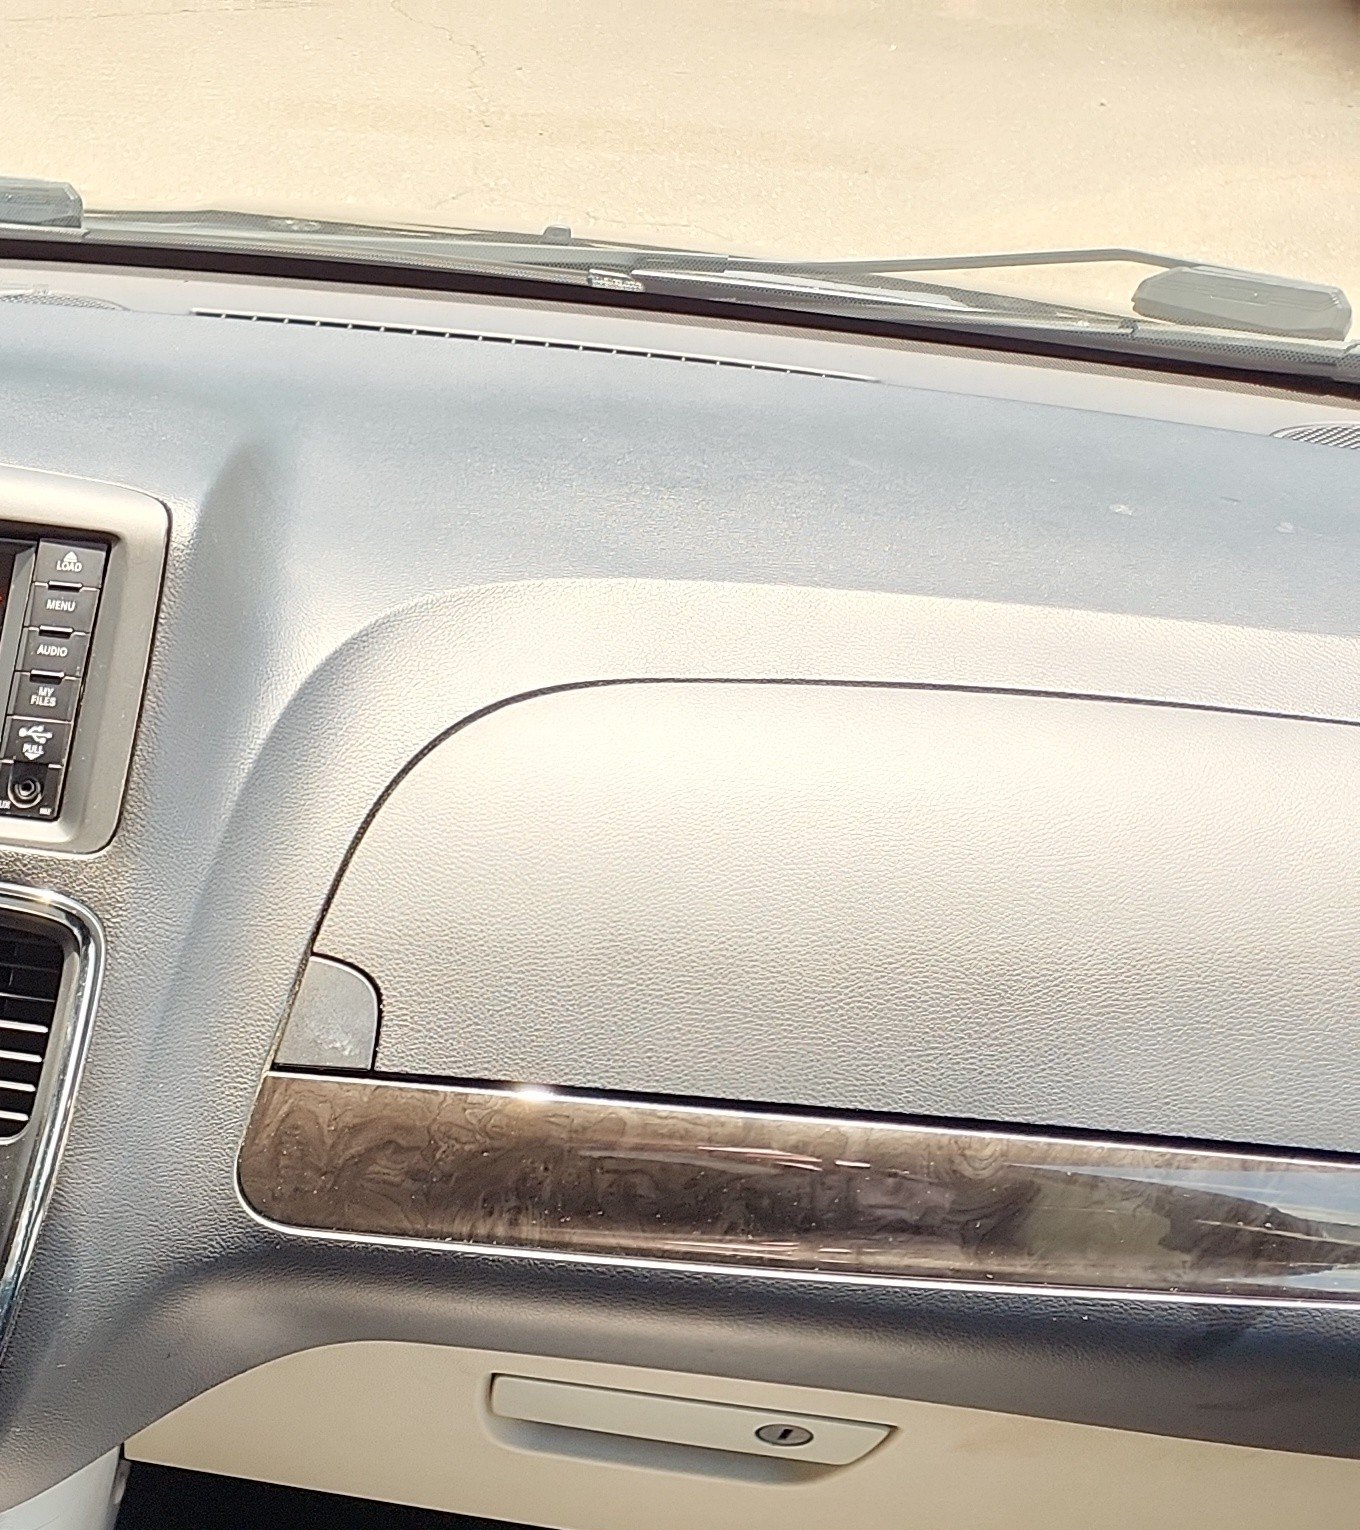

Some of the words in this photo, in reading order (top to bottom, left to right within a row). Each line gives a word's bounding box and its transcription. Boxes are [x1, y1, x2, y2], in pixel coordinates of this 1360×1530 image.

[56, 560, 82, 573] LOAD
[46, 599, 76, 613] MENU
[37, 643, 68, 657] AUDIO
[37, 686, 54, 698] MY
[30, 695, 57, 708] FILES
